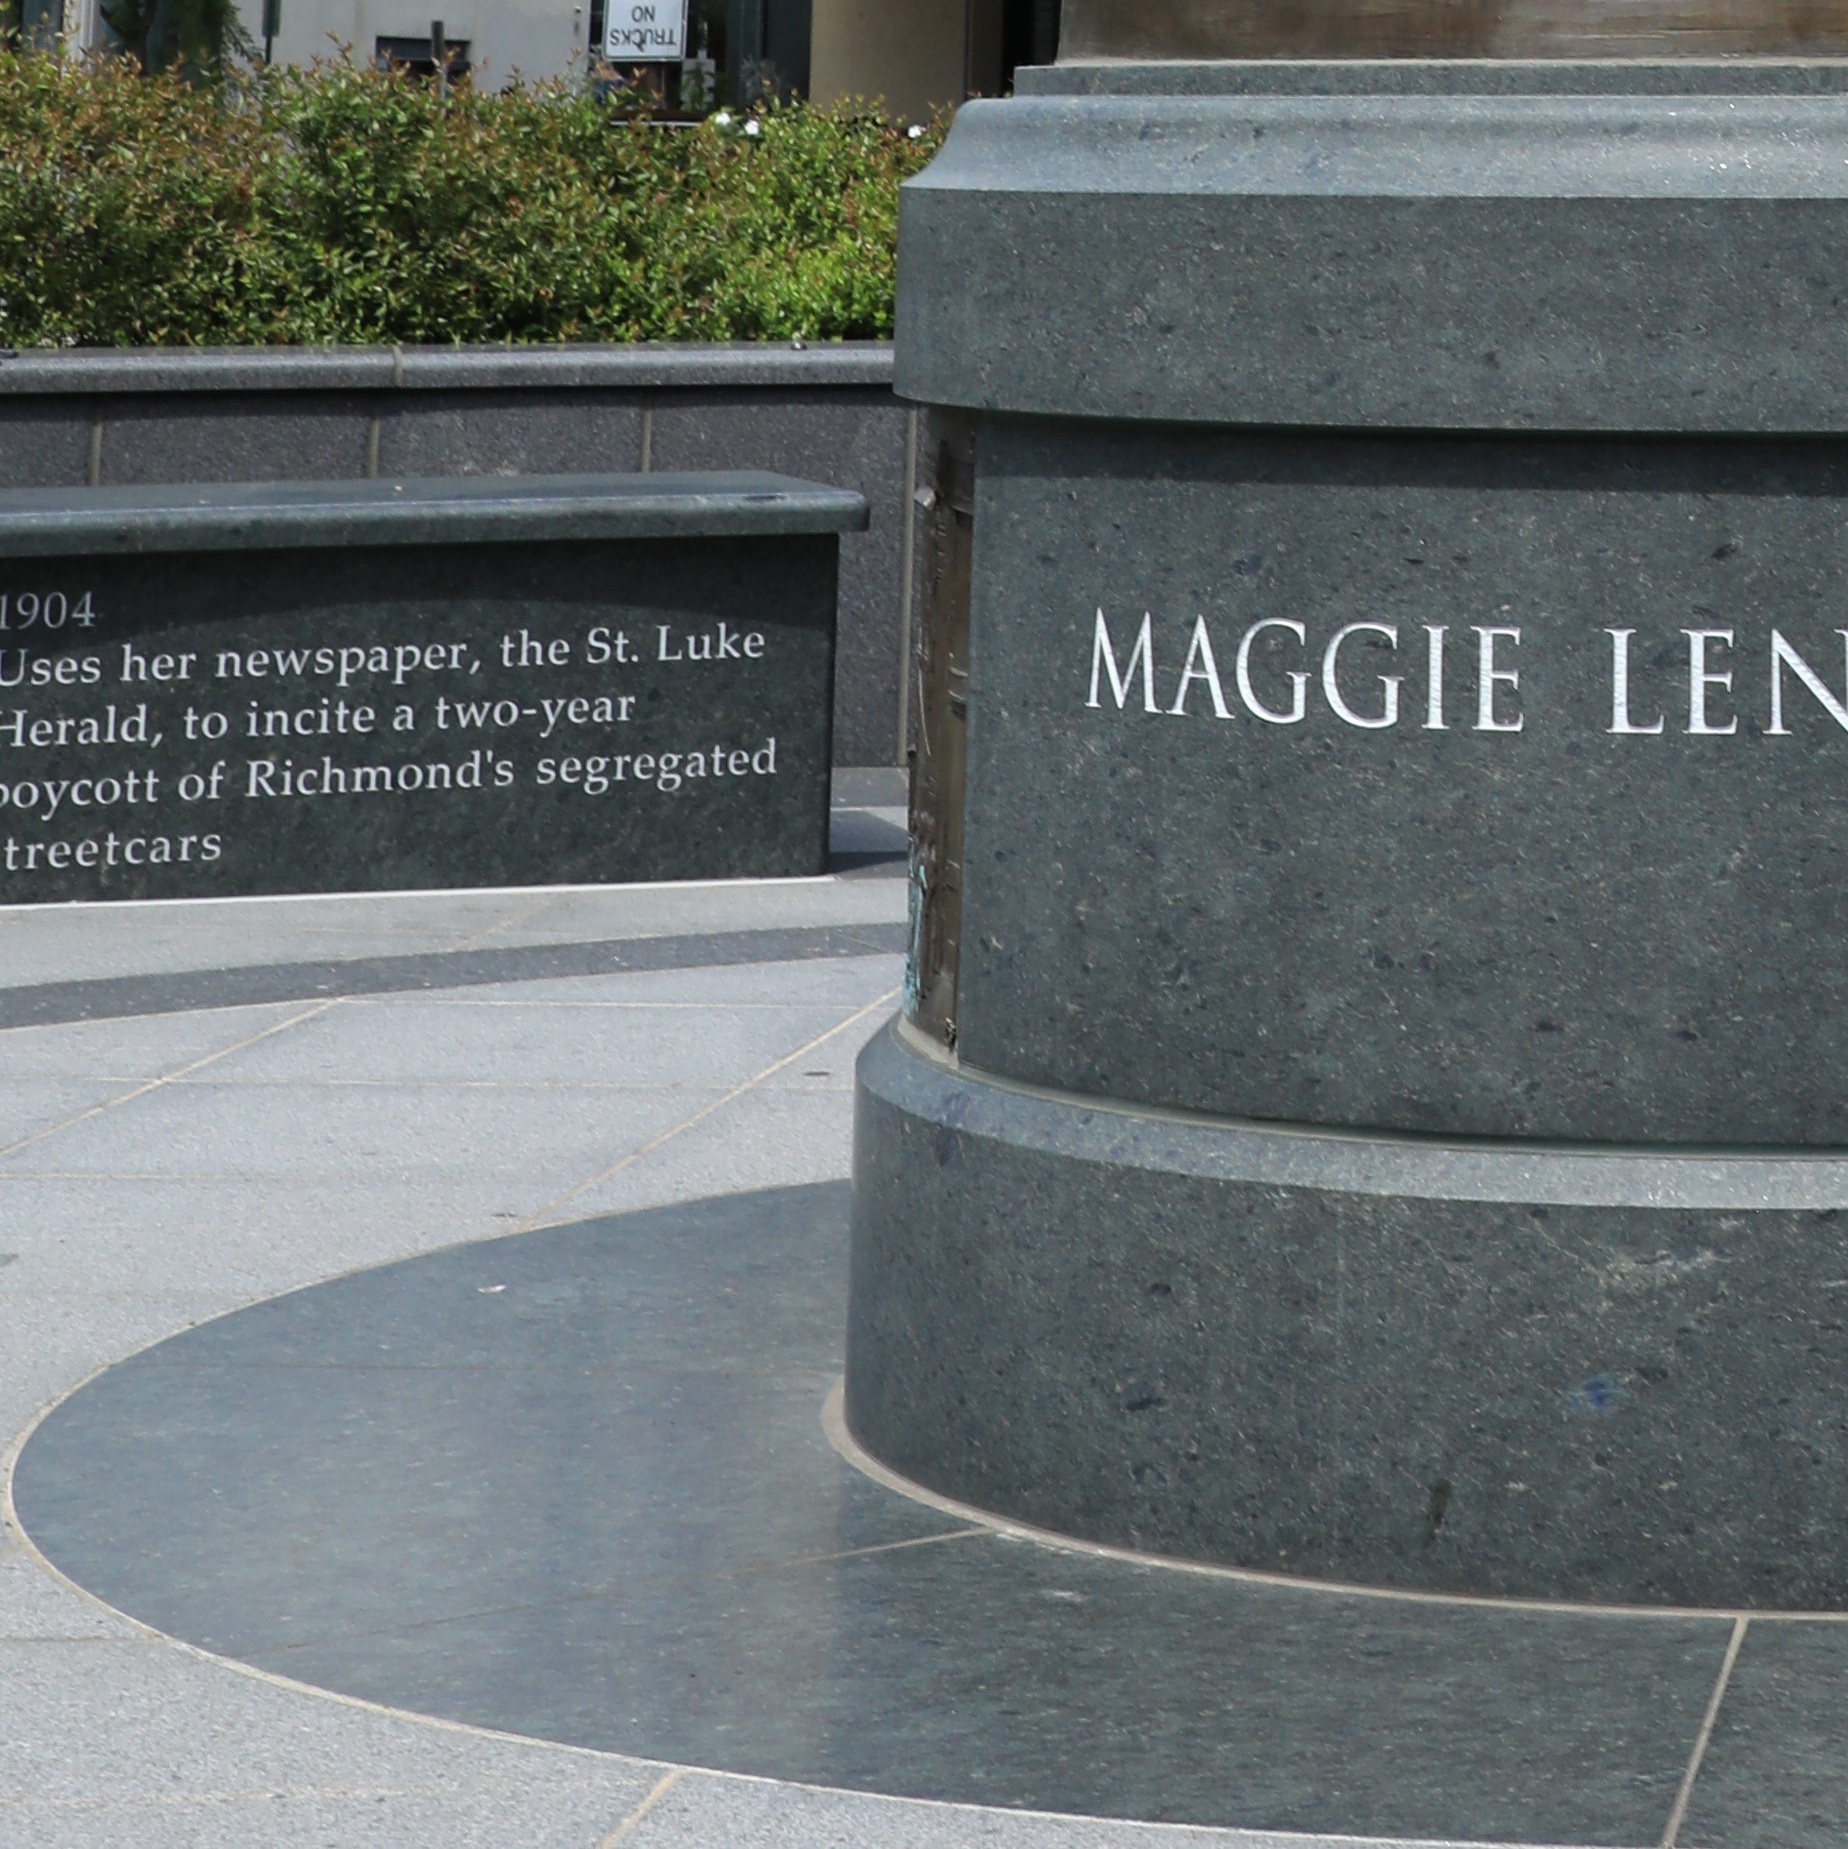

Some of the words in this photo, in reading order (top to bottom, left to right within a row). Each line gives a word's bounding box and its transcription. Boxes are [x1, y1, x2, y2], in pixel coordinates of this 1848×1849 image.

[610, 28, 677, 46] TRUCKS
[631, 6, 656, 22] NO
[0, 591, 96, 630] 1904
[0, 648, 101, 687] Uses
[120, 643, 197, 682] her
[215, 641, 482, 688] newspaper,
[500, 629, 571, 668] the
[586, 627, 640, 664] St.
[656, 622, 766, 661] Luke
[1084, 607, 1524, 732] MAGGIE
[0, 703, 164, 748] Herald,
[184, 707, 229, 740] to
[246, 698, 376, 737] incite
[393, 705, 415, 732] a
[435, 695, 636, 738] two-year
[178, 760, 227, 801] of
[245, 749, 515, 798] Richmond's
[536, 737, 778, 796] segregated
